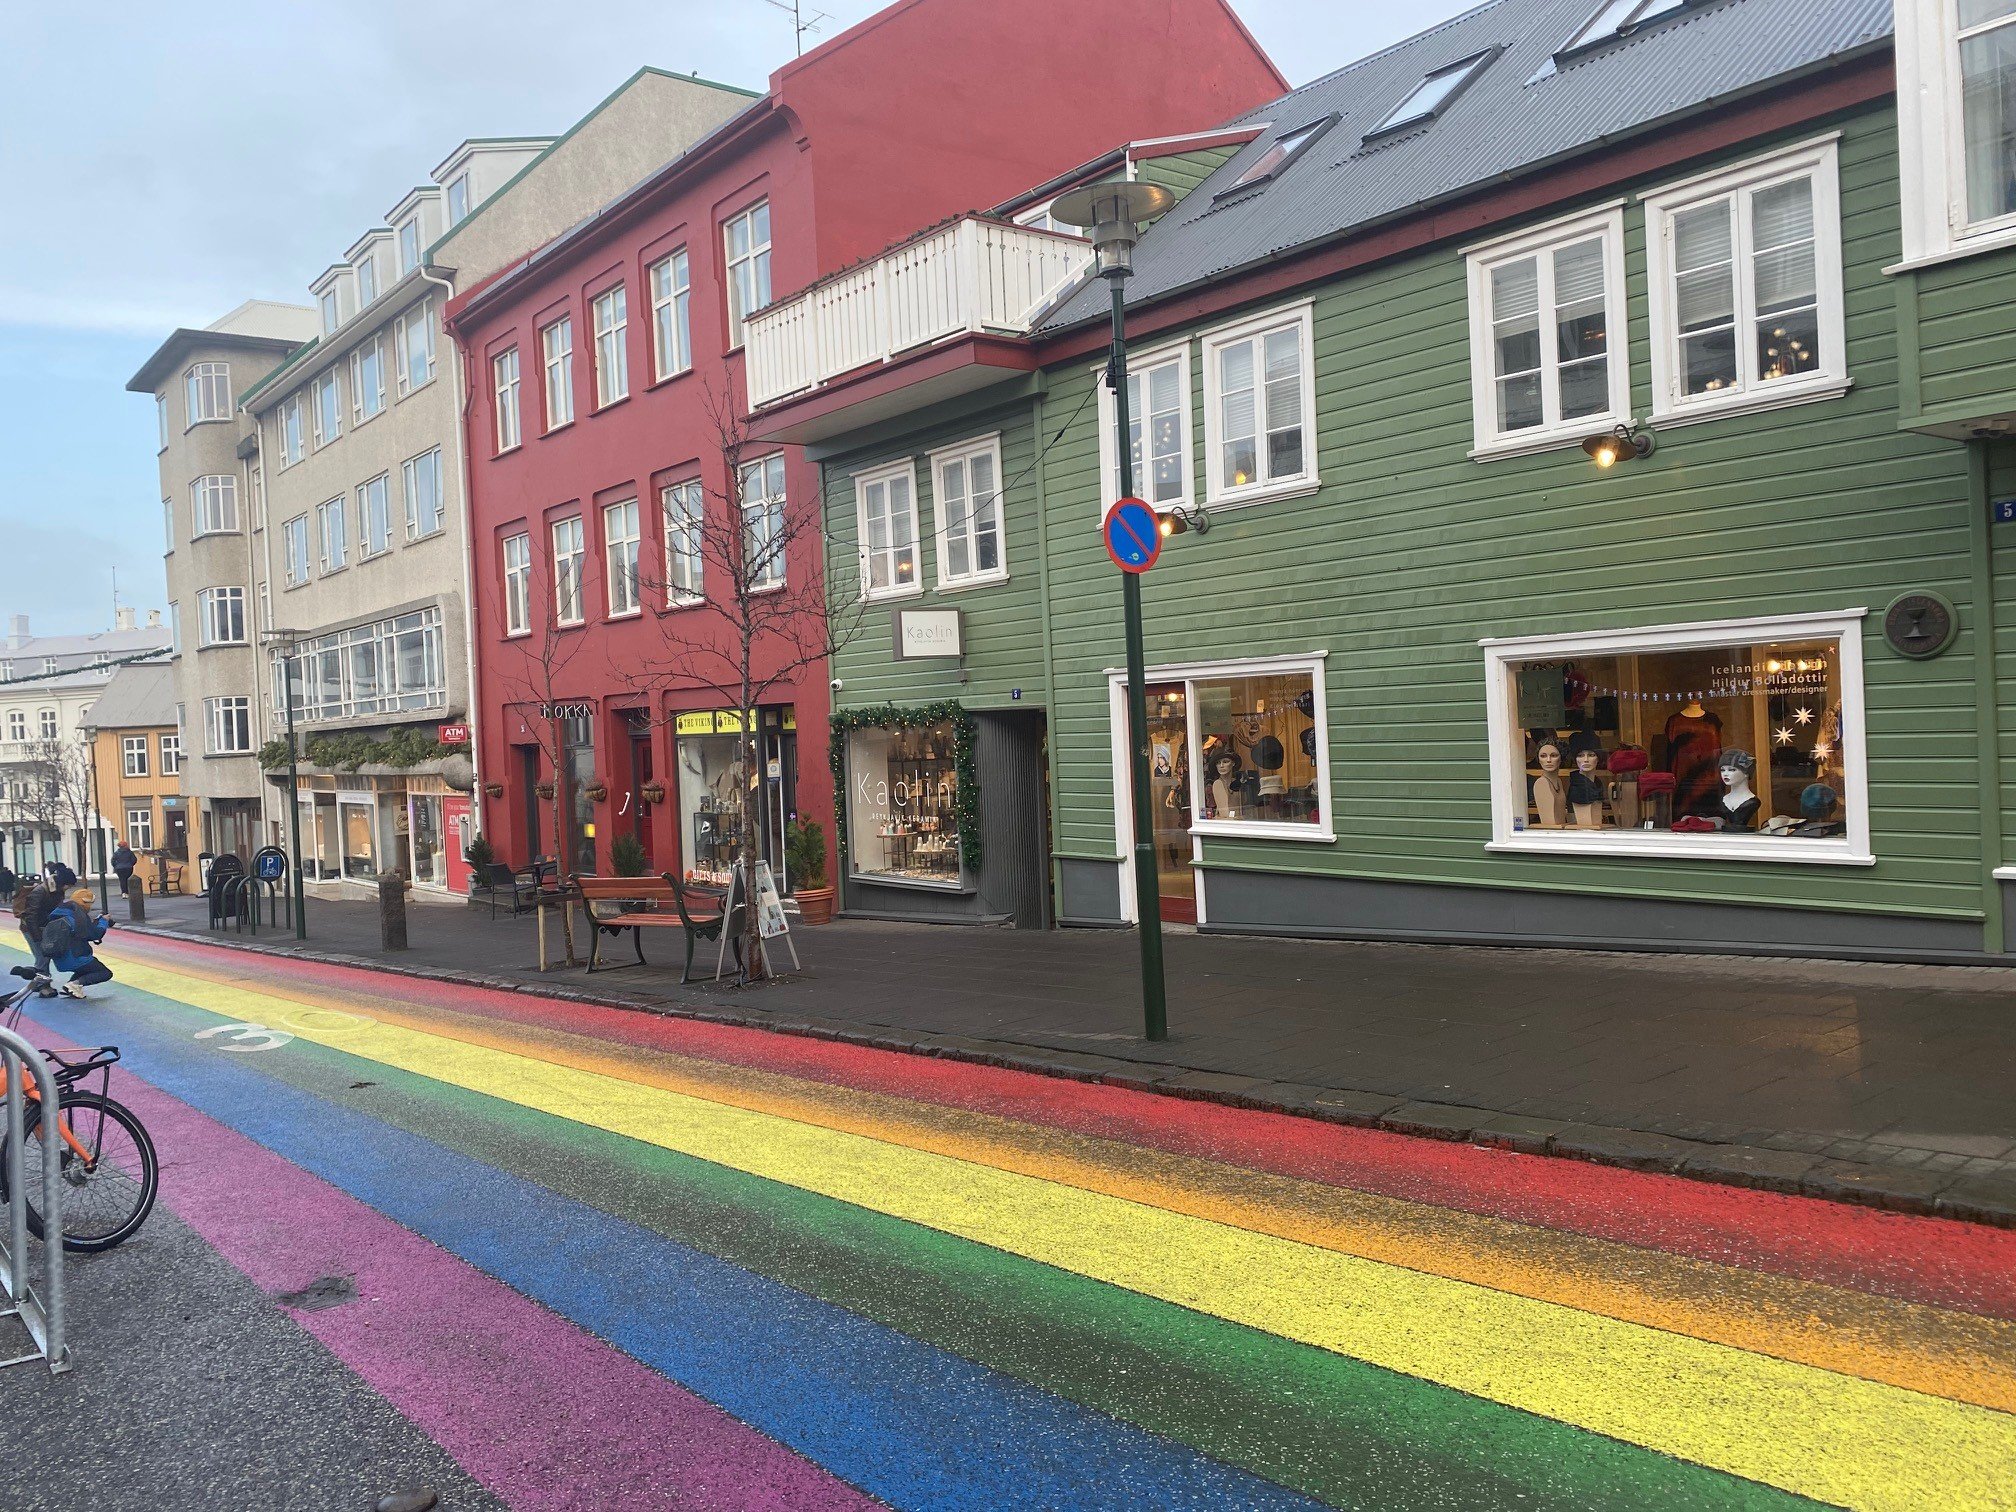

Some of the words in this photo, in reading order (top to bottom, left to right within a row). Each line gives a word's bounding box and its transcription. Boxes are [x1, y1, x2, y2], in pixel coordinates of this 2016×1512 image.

[2004, 502, 2013, 518] 5
[907, 625, 952, 639] Kaolin
[1711, 661, 1777, 675] Icelandi
[1780, 659, 1828, 671] deign
[1712, 675, 1751, 688] Hildur
[1755, 671, 1828, 686] Bolladóttir
[1741, 685, 1828, 697] dressmaker/designer
[684, 718, 694, 727] THE
[445, 728, 464, 736] ATM
[857, 769, 951, 809] Kaolin
[267, 857, 274, 867] P
[711, 871, 718, 882] &
